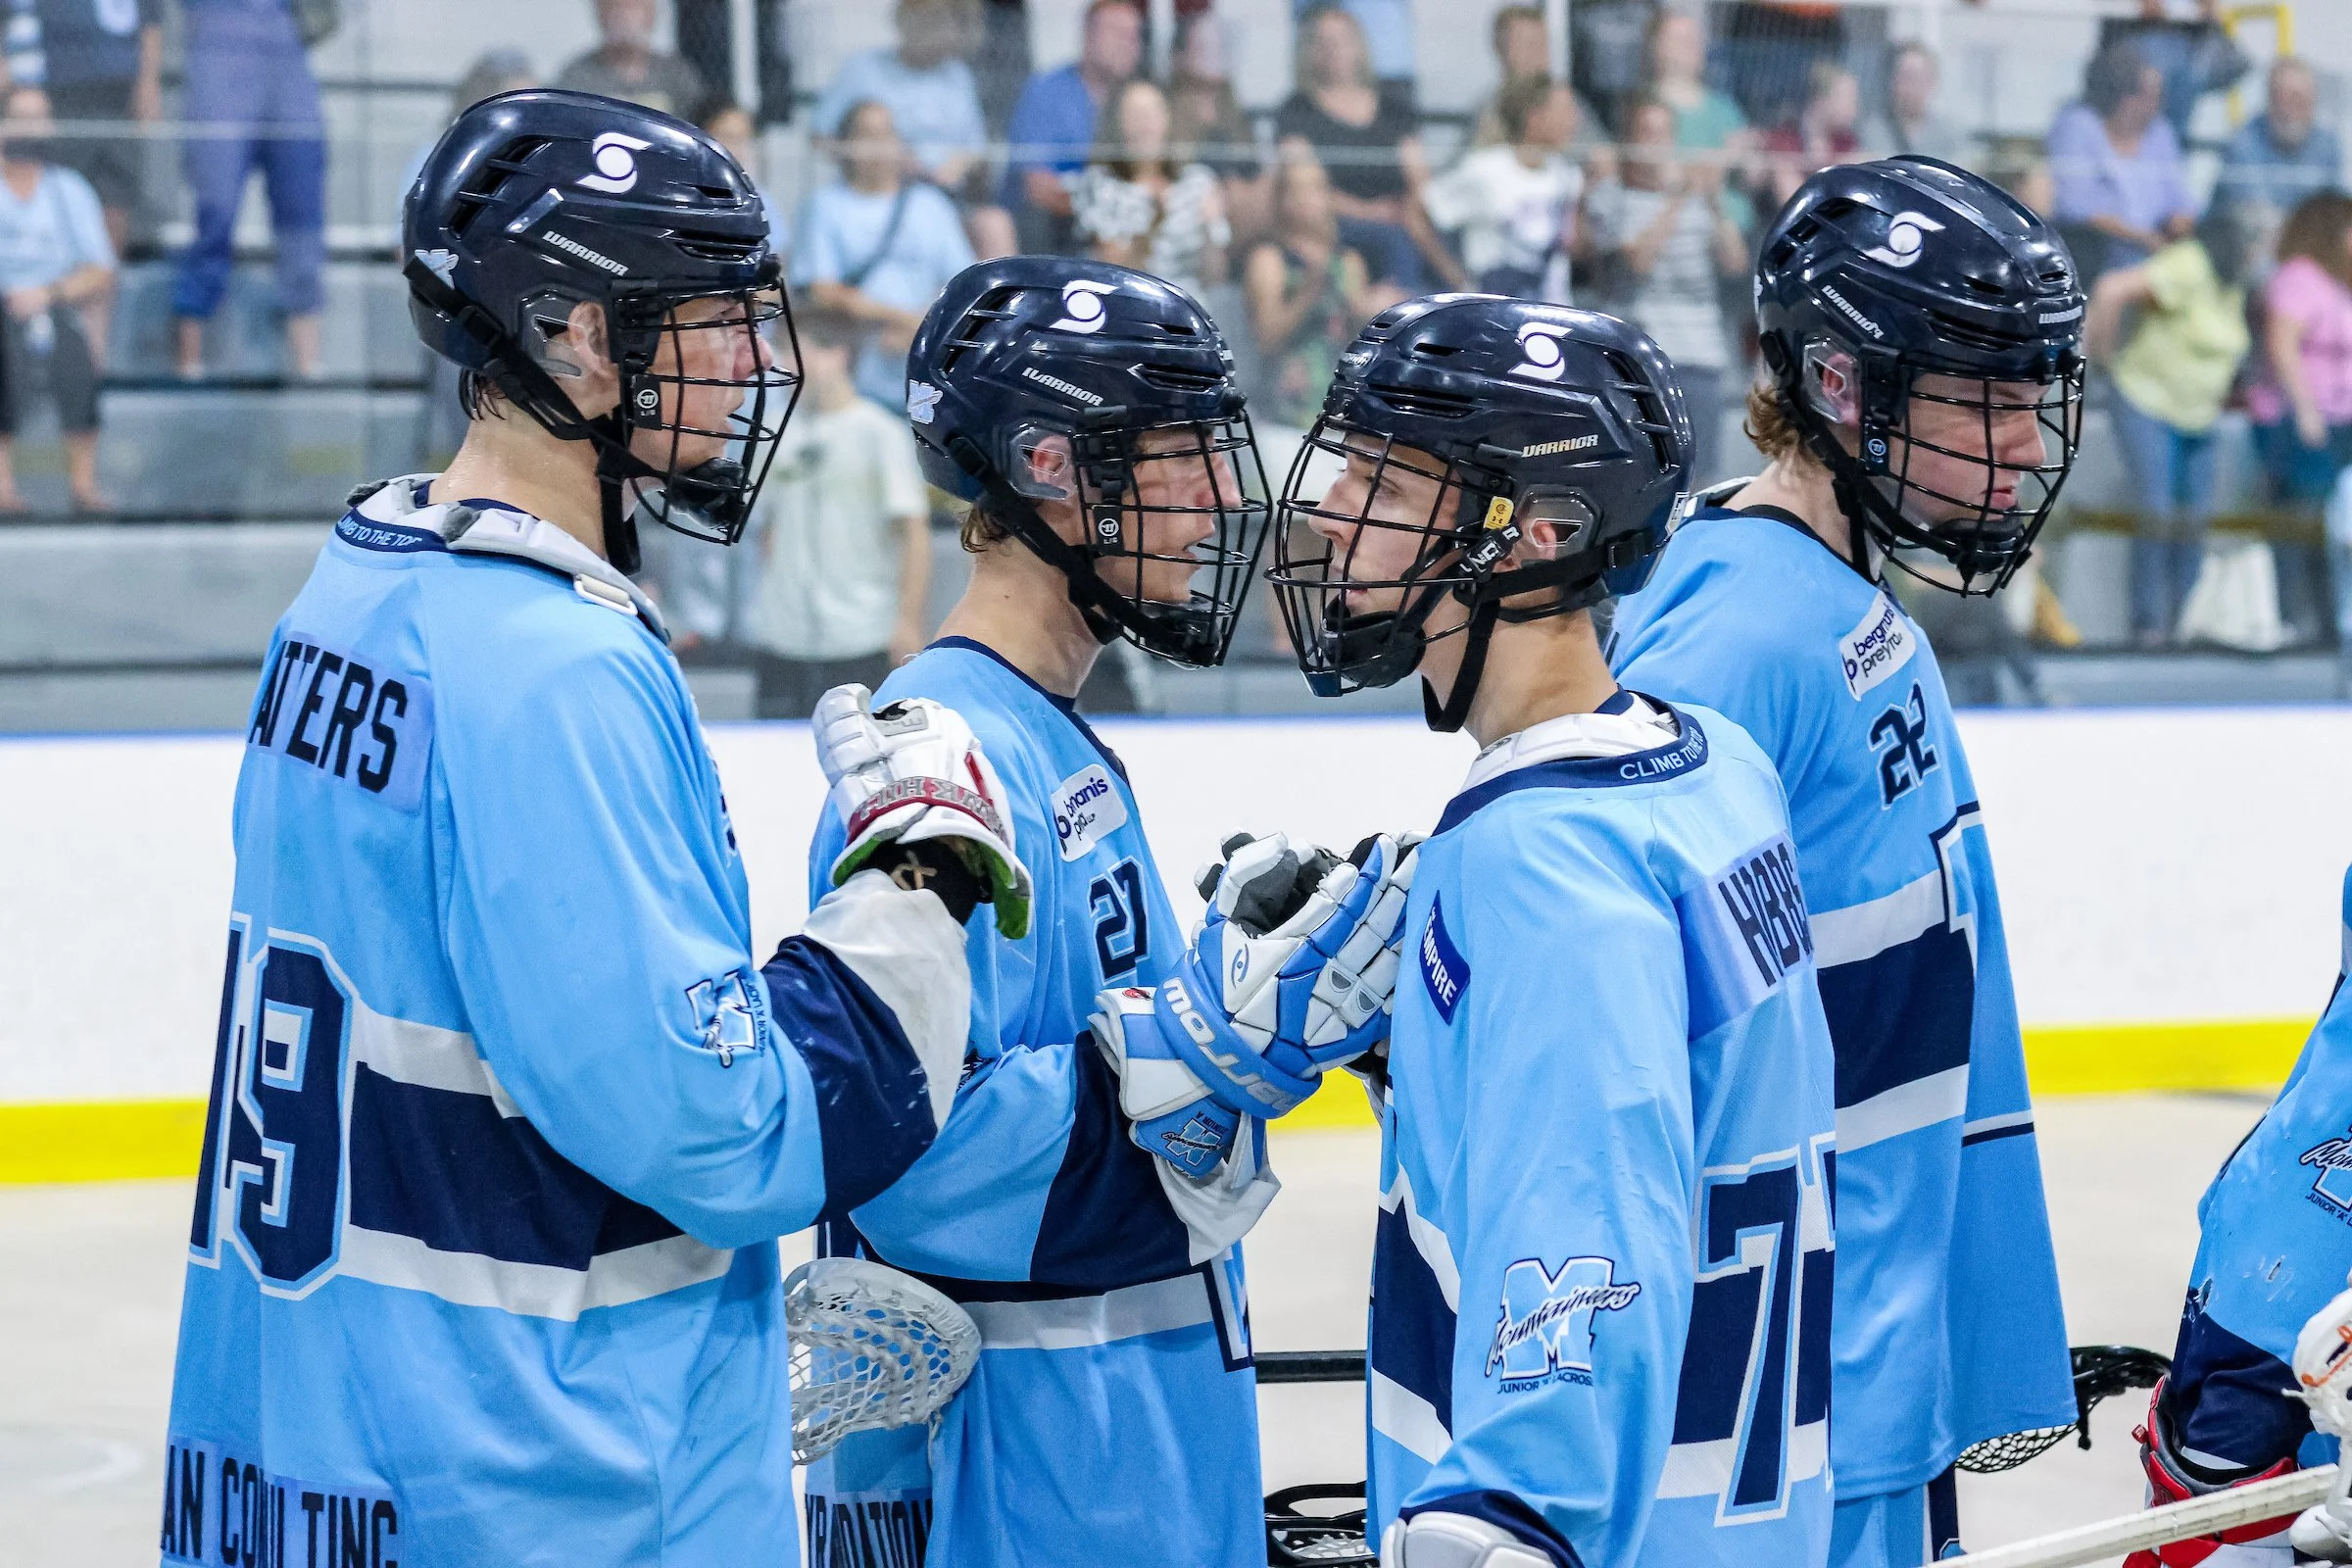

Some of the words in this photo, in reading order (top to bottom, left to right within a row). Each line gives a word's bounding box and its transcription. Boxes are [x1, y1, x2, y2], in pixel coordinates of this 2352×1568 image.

[542, 230, 629, 276] WARRIOR
[1021, 367, 1104, 407] WARRIOR
[353, 525, 371, 541] TO
[368, 529, 396, 546] THE
[1620, 752, 1685, 779] CLIMB
[1866, 677, 1941, 811] 22
[1087, 855, 1151, 987] 27
[188, 911, 361, 1301] 19
[2304, 1192, 2336, 1216] JUNIOR
[1693, 1132, 1837, 1528] 7
[1497, 1380, 1540, 1395] JUNIOR
